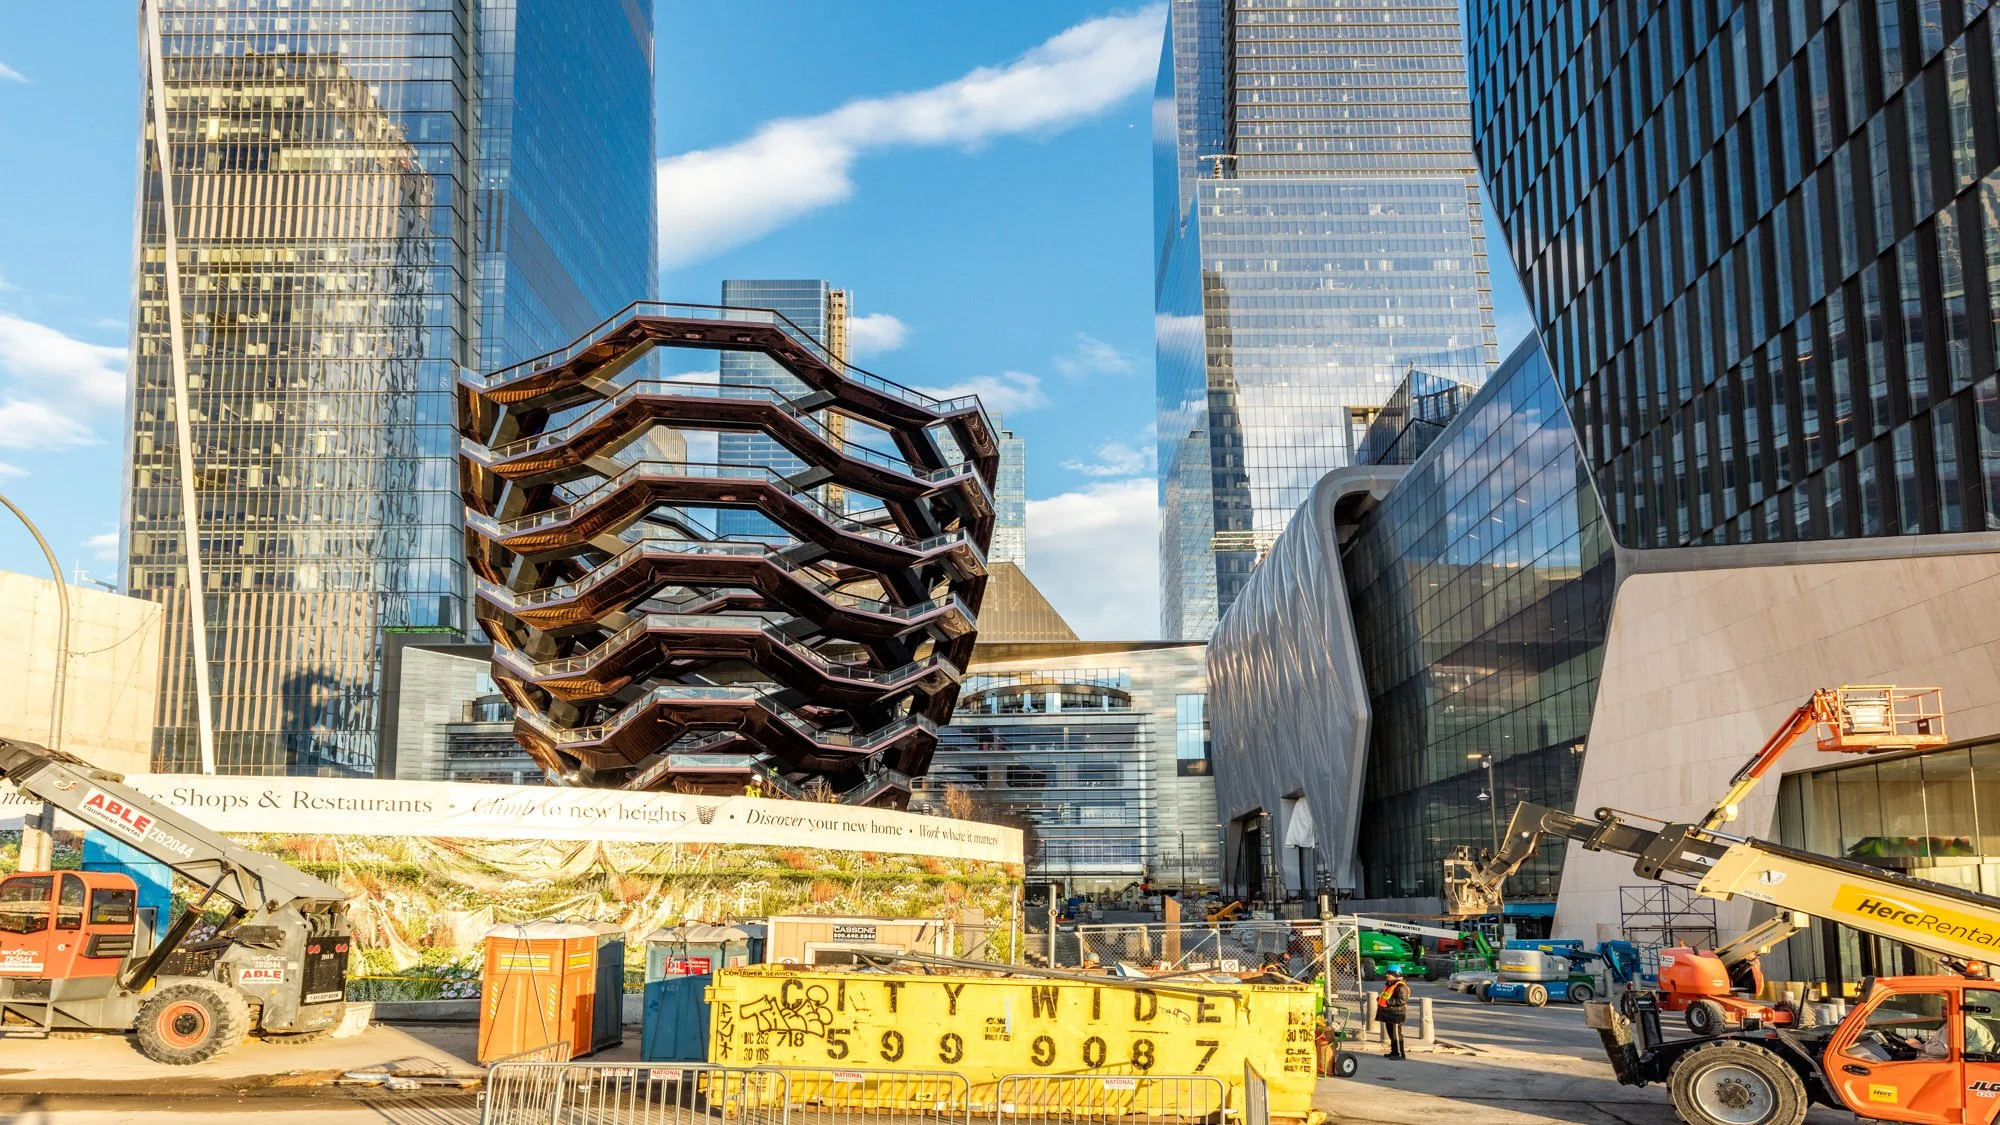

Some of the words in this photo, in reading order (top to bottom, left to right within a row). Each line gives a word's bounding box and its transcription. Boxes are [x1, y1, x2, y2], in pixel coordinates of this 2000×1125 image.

[171, 787, 249, 813] Shops
[258, 790, 281, 809] &
[293, 790, 433, 813] Restaurants
[83, 804, 118, 825] EQUIPMENT
[118, 822, 141, 838] RENTAL
[85, 794, 151, 833] ABLE
[570, 804, 612, 819] new
[619, 803, 687, 824] heights
[746, 808, 807, 828] Discover
[807, 818, 838, 832] your
[842, 821, 868, 834] new
[871, 820, 903, 836] home
[148, 827, 195, 859] ZB2044
[919, 824, 941, 840] Work
[942, 828, 966, 842] where
[973, 834, 998, 846] matters
[833, 926, 876, 934] CASSONE
[1856, 899, 2000, 948] HercRental
[242, 970, 282, 979] ABLE
[780, 978, 966, 1017] CITY
[1031, 986, 1222, 1024] WIDE
[756, 1031, 770, 1045] 252
[1286, 1028, 1297, 1042] 30
[743, 1047, 754, 1061] 30
[756, 1047, 770, 1061] YDS
[776, 1031, 805, 1047] 718
[827, 1028, 963, 1064] 599
[1031, 1035, 1220, 1074] 9087
[834, 1071, 864, 1079] NATIONAL
[1967, 1080, 2000, 1092] JLG
[1873, 1089, 1893, 1097] Herc
